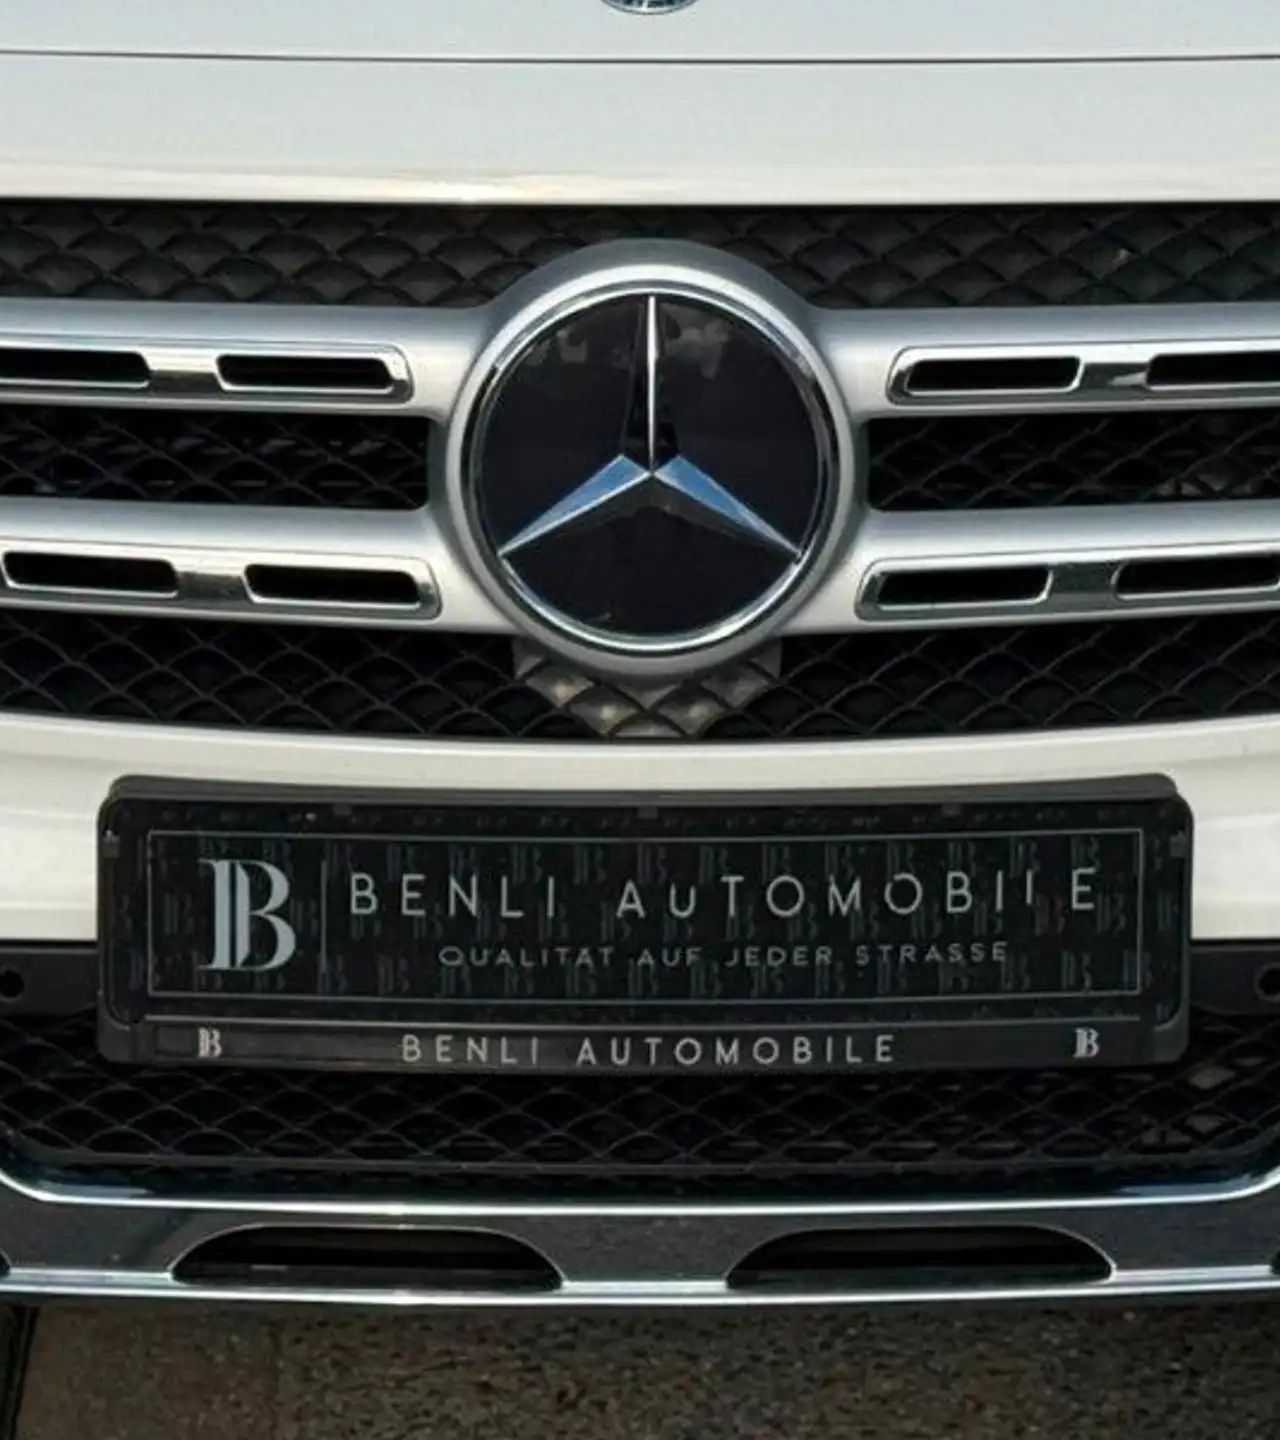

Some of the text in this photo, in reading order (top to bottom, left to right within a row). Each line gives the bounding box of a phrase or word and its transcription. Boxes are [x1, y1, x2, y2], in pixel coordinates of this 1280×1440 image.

[350, 872, 556, 918] BENLI
[636, 946, 702, 967] AUF
[724, 944, 833, 968] JEDER
[855, 940, 1008, 966] STRASSE
[401, 1033, 895, 1066] BENLI AUTOMOBILE
